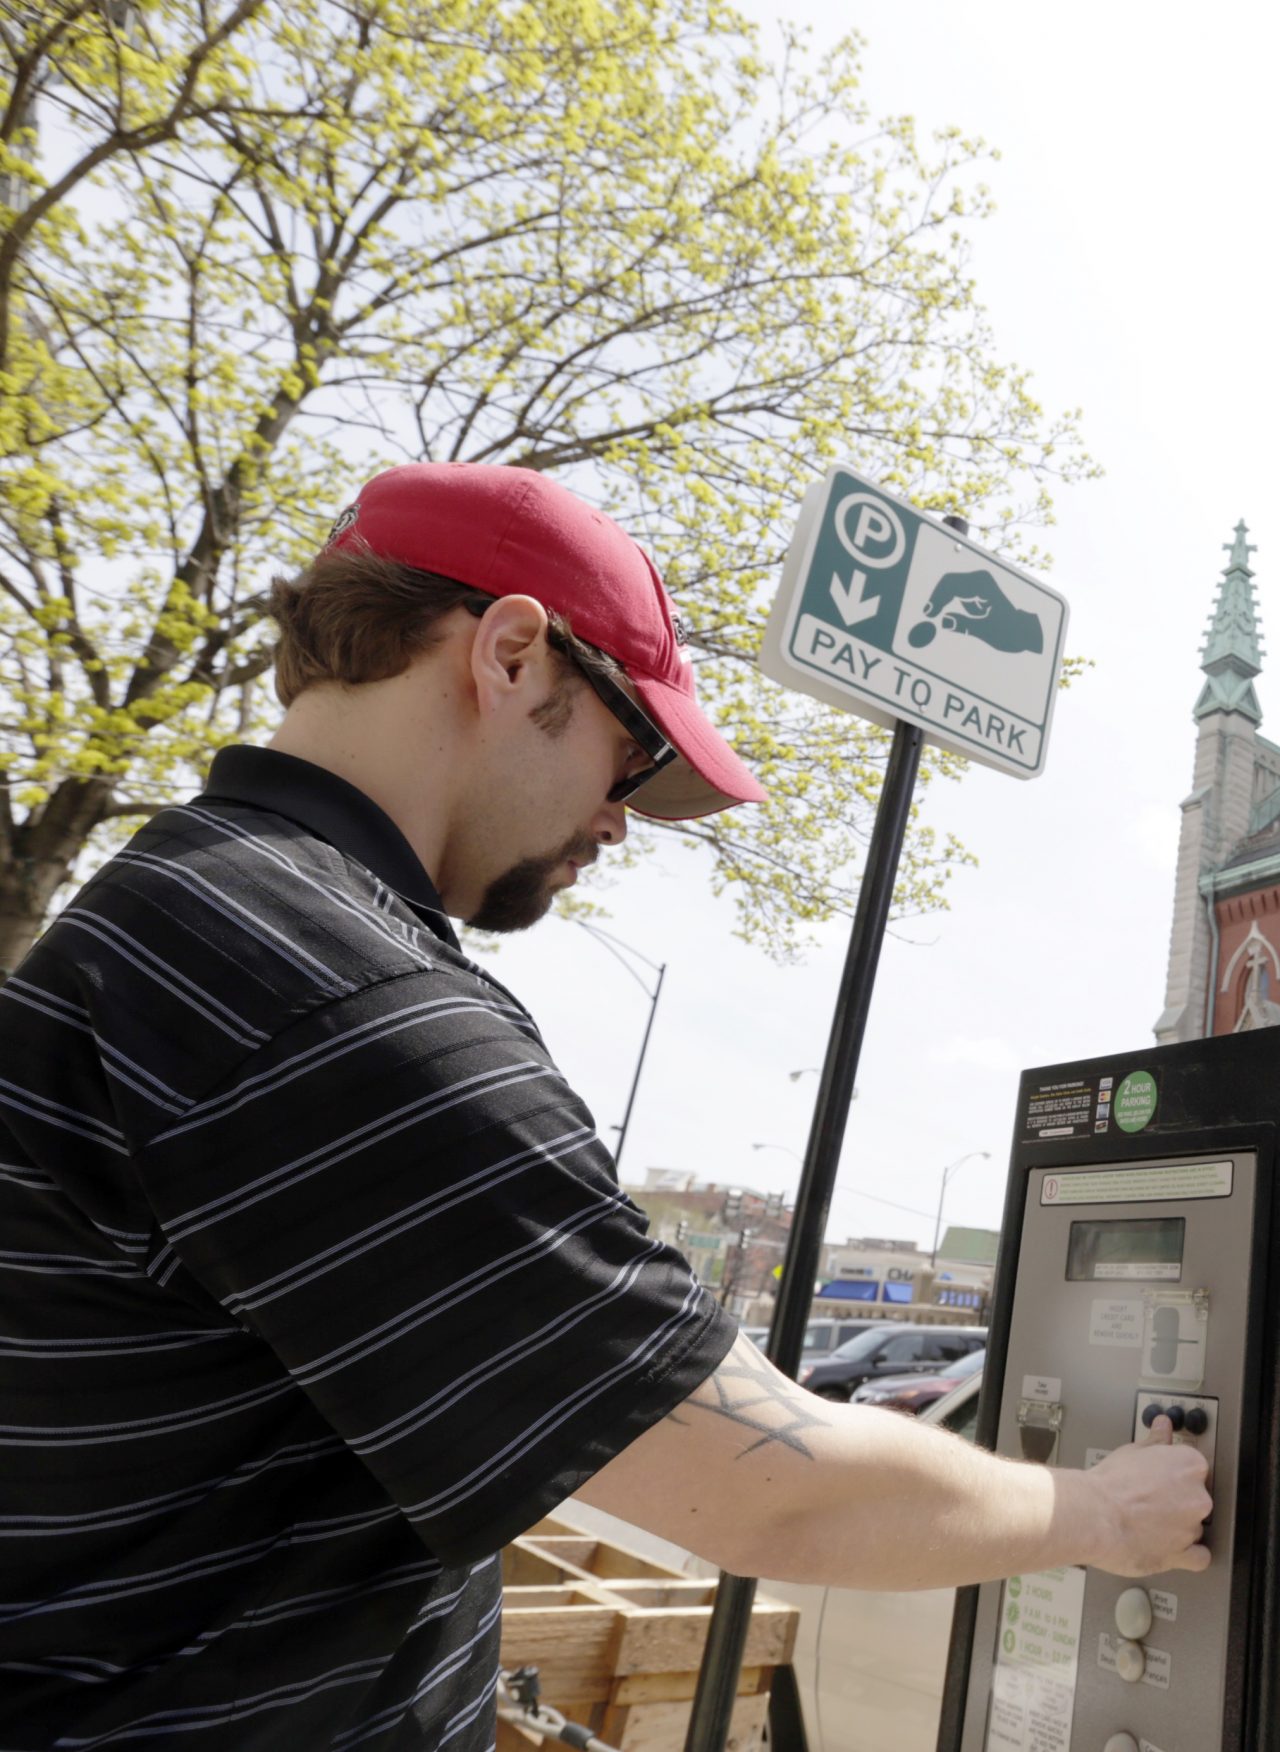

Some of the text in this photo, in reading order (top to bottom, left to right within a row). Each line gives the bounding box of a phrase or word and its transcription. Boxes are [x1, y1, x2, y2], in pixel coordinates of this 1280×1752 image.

[853, 504, 893, 549] P
[810, 627, 1029, 756] PAY TO PARK
[1120, 1095, 1152, 1108] PARKING
[1123, 1079, 1152, 1095] 2 HOUR
